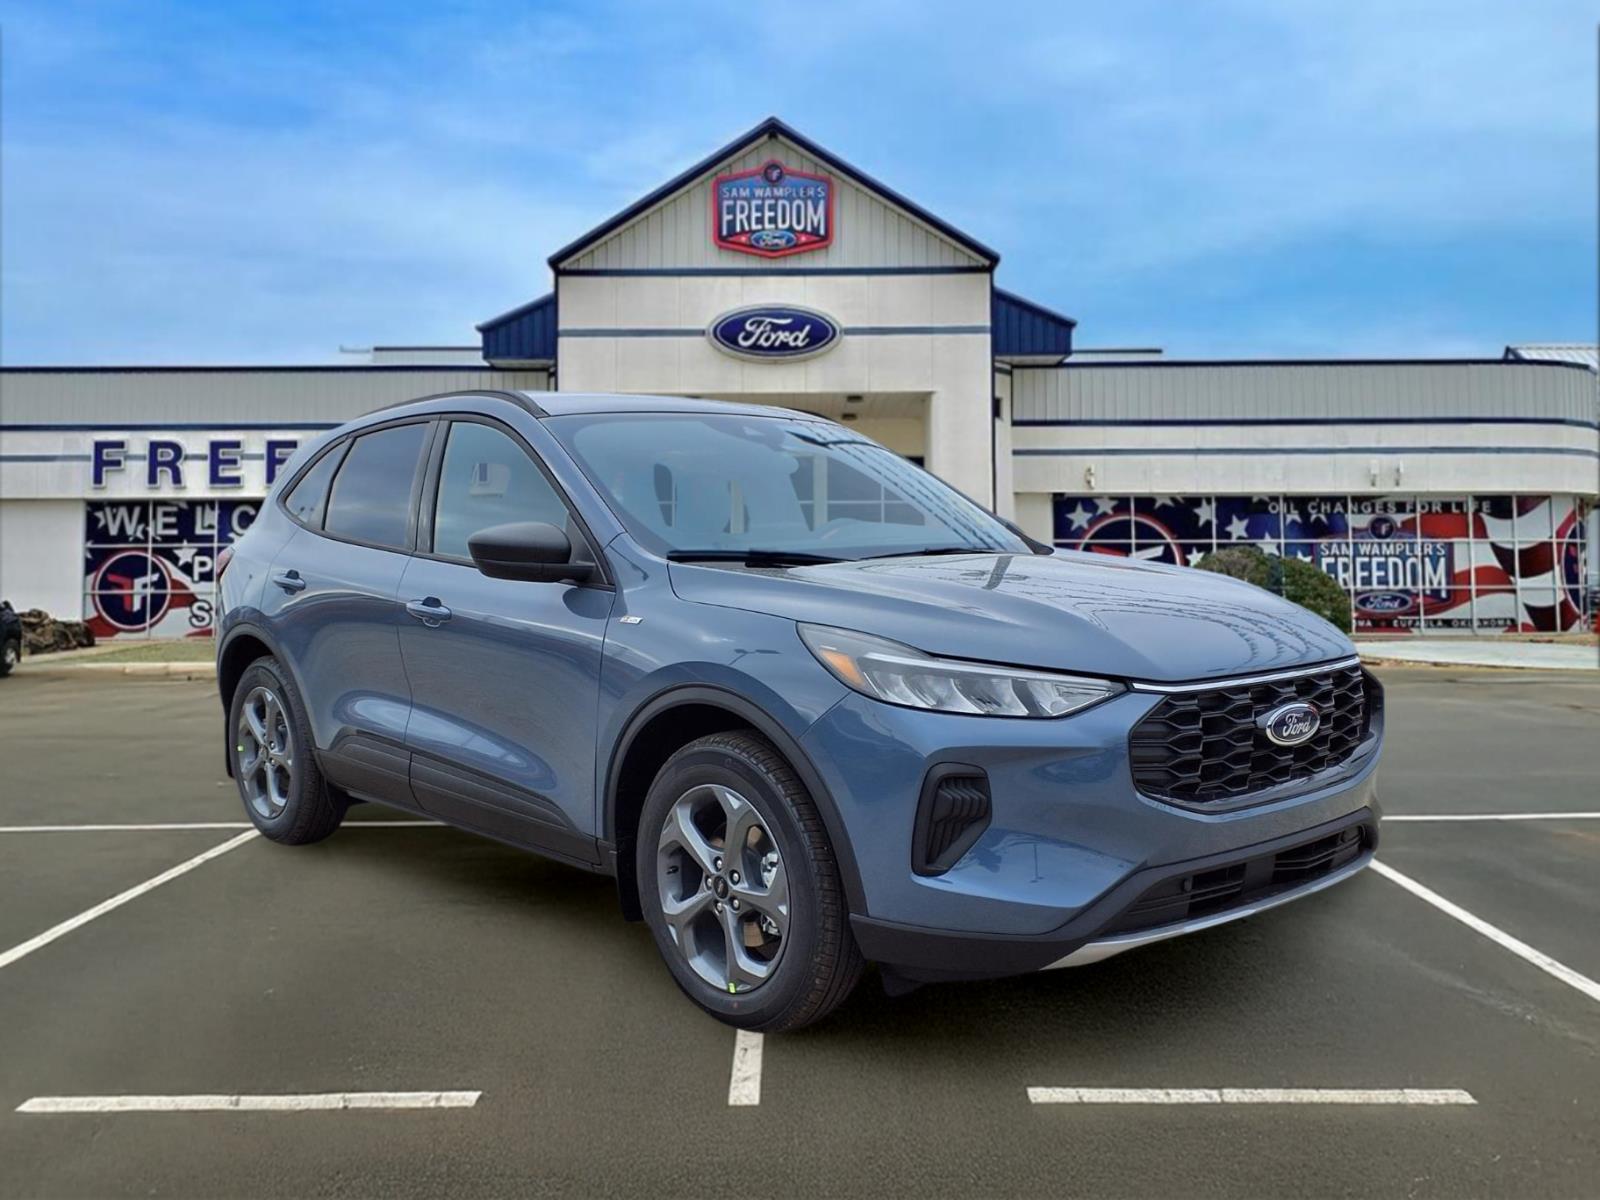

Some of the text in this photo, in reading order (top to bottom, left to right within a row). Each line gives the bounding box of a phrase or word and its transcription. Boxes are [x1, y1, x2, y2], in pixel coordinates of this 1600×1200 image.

[722, 187, 750, 197] SAM
[722, 200, 825, 236] FREEDOM
[738, 317, 811, 347] Ford
[1268, 501, 1491, 514] OIL CHANGES FOR LIFE
[1322, 557, 1447, 598] FREEDOM
[1283, 713, 1312, 737] Ford
